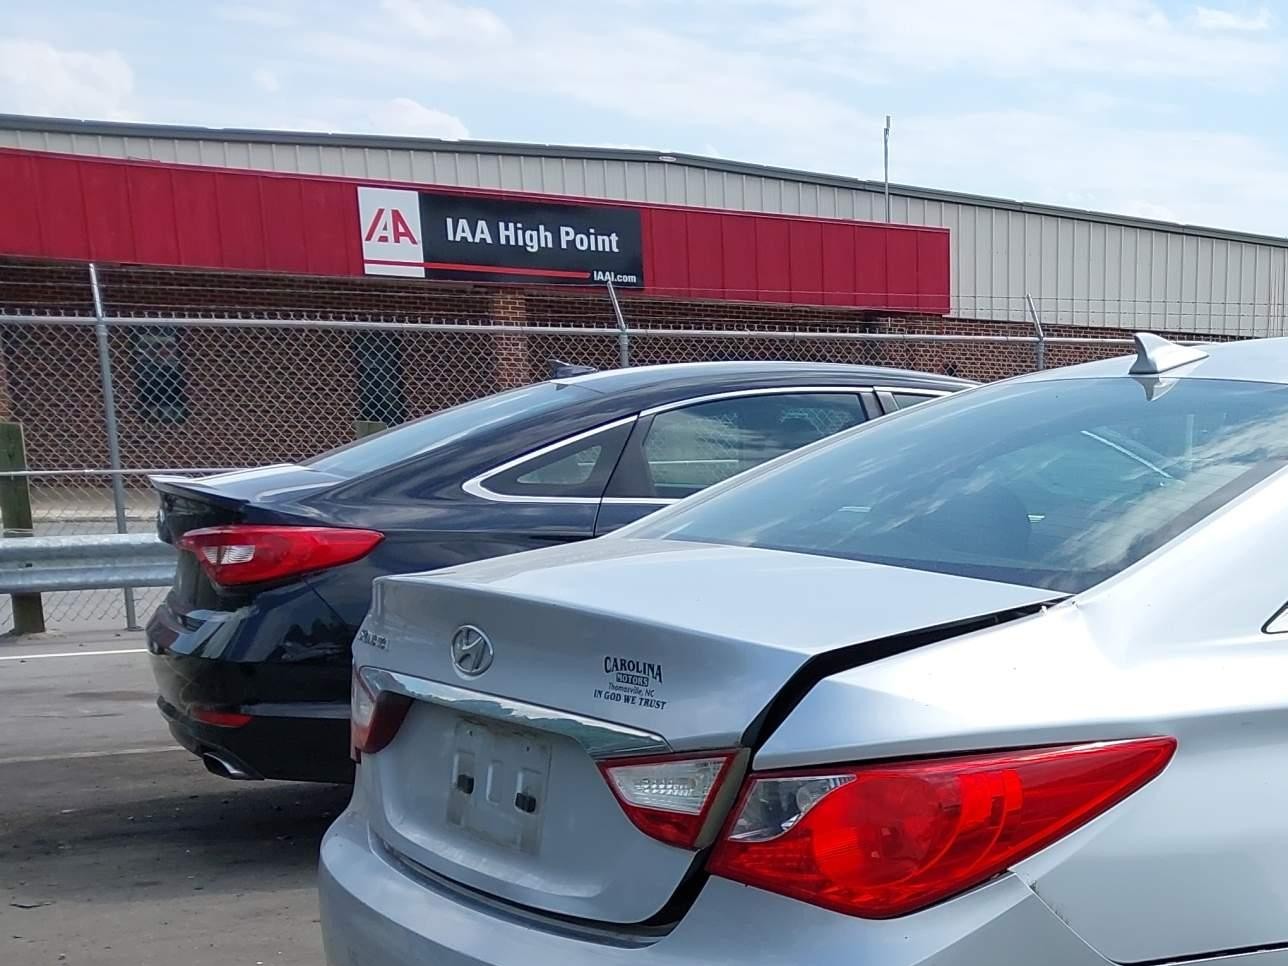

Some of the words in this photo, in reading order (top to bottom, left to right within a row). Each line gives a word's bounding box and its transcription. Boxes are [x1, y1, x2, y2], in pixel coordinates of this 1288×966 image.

[446, 217, 492, 244] IAA
[499, 221, 552, 252] High
[560, 226, 619, 252] Point
[593, 270, 637, 283] IAAI.com
[604, 656, 662, 684] CAROLINA
[616, 673, 649, 687] MOTORS
[594, 688, 603, 699] IN
[604, 691, 621, 702] GOD
[624, 694, 637, 705] WE
[639, 697, 667, 710] TRUST
[645, 688, 655, 698] NC
